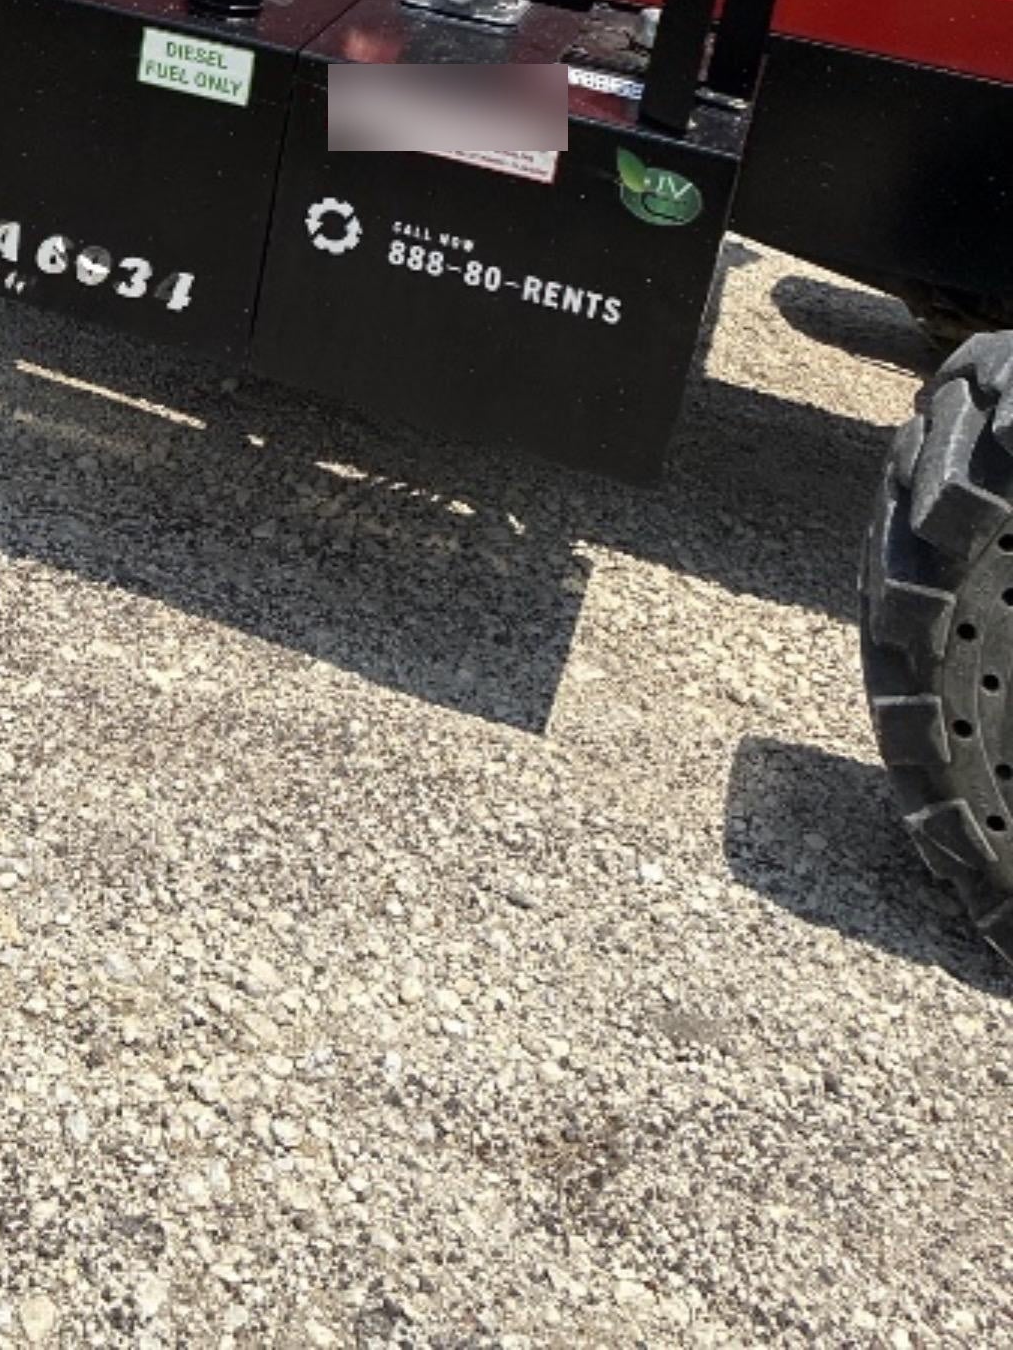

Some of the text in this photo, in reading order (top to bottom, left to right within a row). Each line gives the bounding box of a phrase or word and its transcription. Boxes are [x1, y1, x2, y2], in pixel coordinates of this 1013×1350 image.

[146, 60, 242, 97] FUEL ONLY
[166, 41, 228, 70] DIESEL
[36, 234, 195, 312] 6034
[388, 239, 623, 326] 888-80-RENTS
